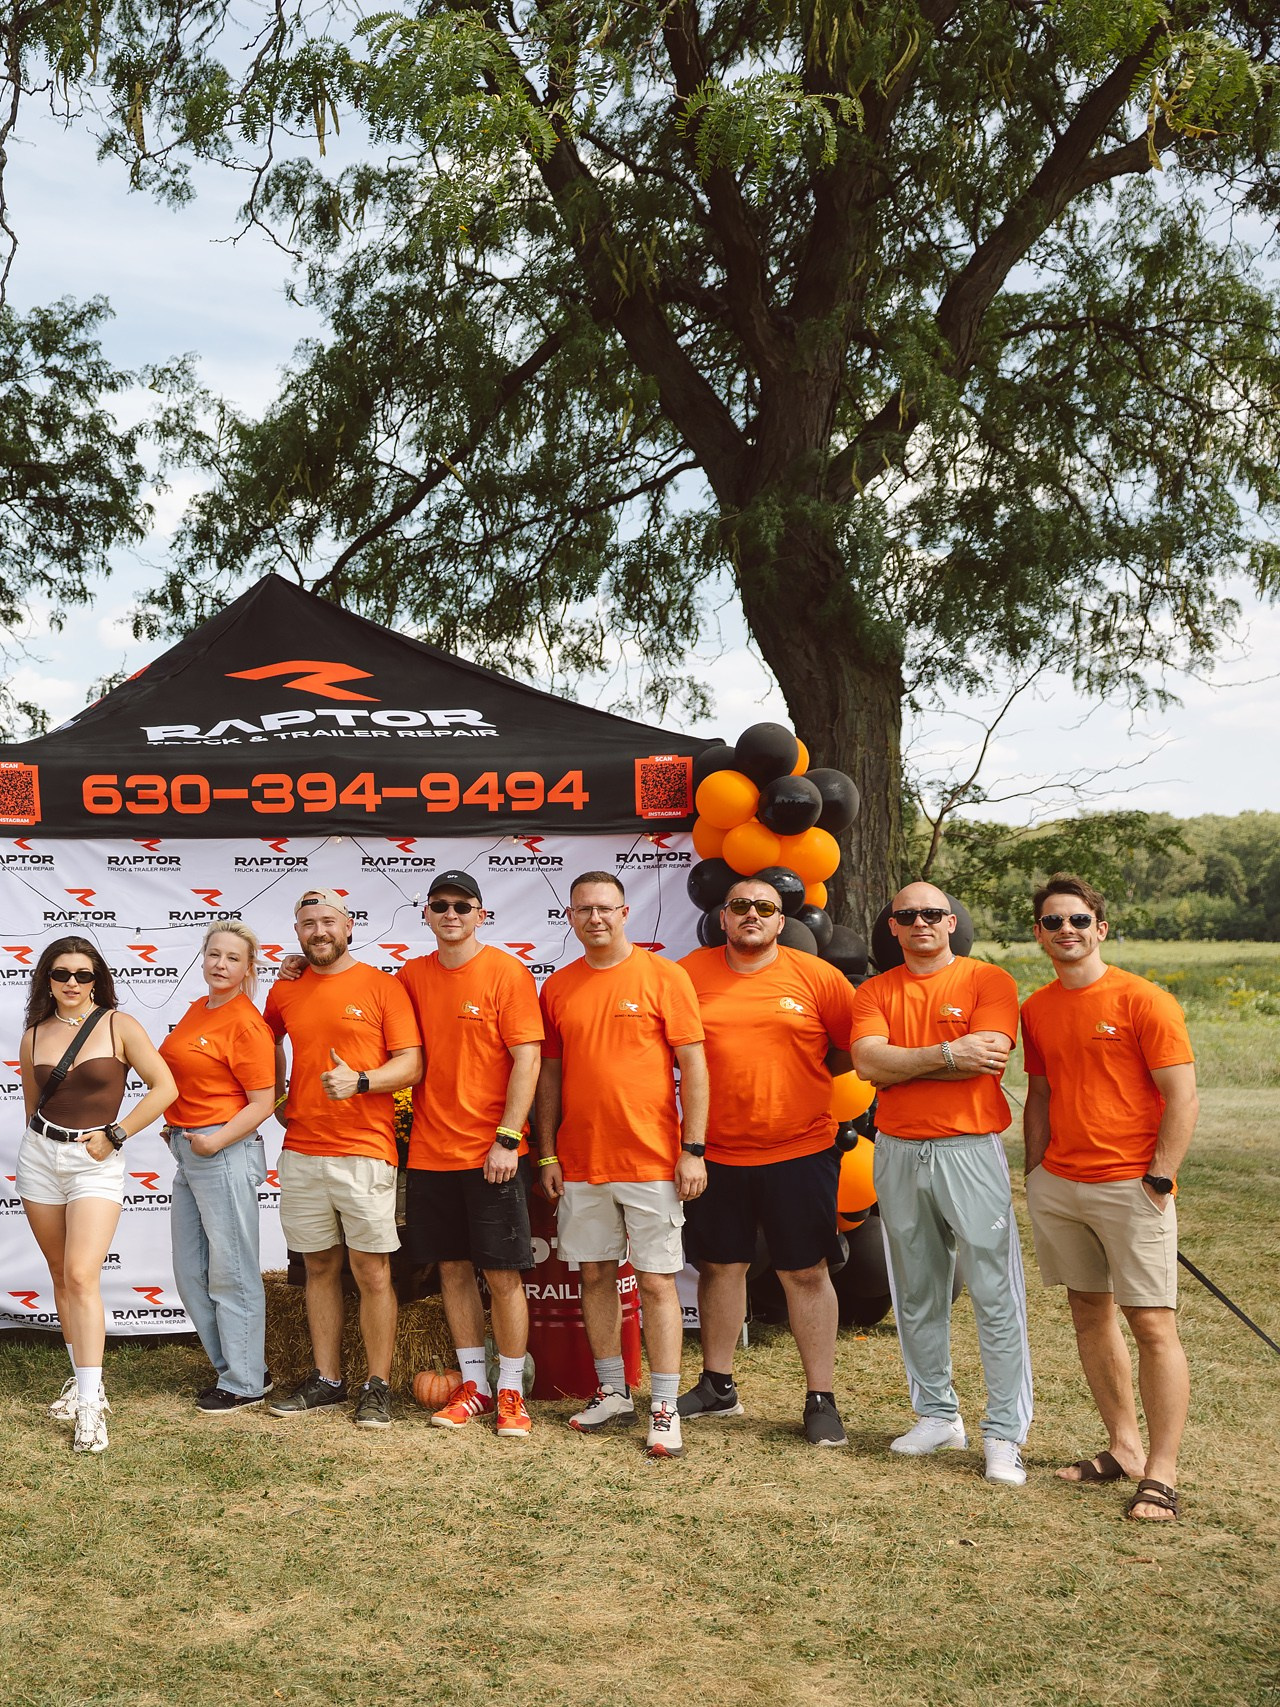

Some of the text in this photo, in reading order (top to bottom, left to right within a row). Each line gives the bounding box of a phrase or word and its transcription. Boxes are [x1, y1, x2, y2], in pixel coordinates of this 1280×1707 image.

[139, 708, 497, 741] RAPTOR
[249, 735, 268, 743] &
[274, 729, 392, 741] TRAILER
[397, 729, 500, 738] REPAIR
[81, 770, 590, 815] 630-394-9494
[107, 855, 181, 866] RAPTOR
[234, 856, 309, 866] RAPTOR
[361, 856, 436, 867] RAPTOR
[488, 856, 564, 866] RAPTOR
[615, 852, 692, 863] RAPTOR
[43, 911, 117, 922] RAPTOR
[169, 911, 242, 922] RAPTOR
[109, 967, 179, 978] RAPTOR
[122, 1194, 172, 1204] APTO
[616, 1275, 637, 1295] REP
[523, 1283, 581, 1299] RAIL
[112, 1308, 186, 1320] RAPTOR
